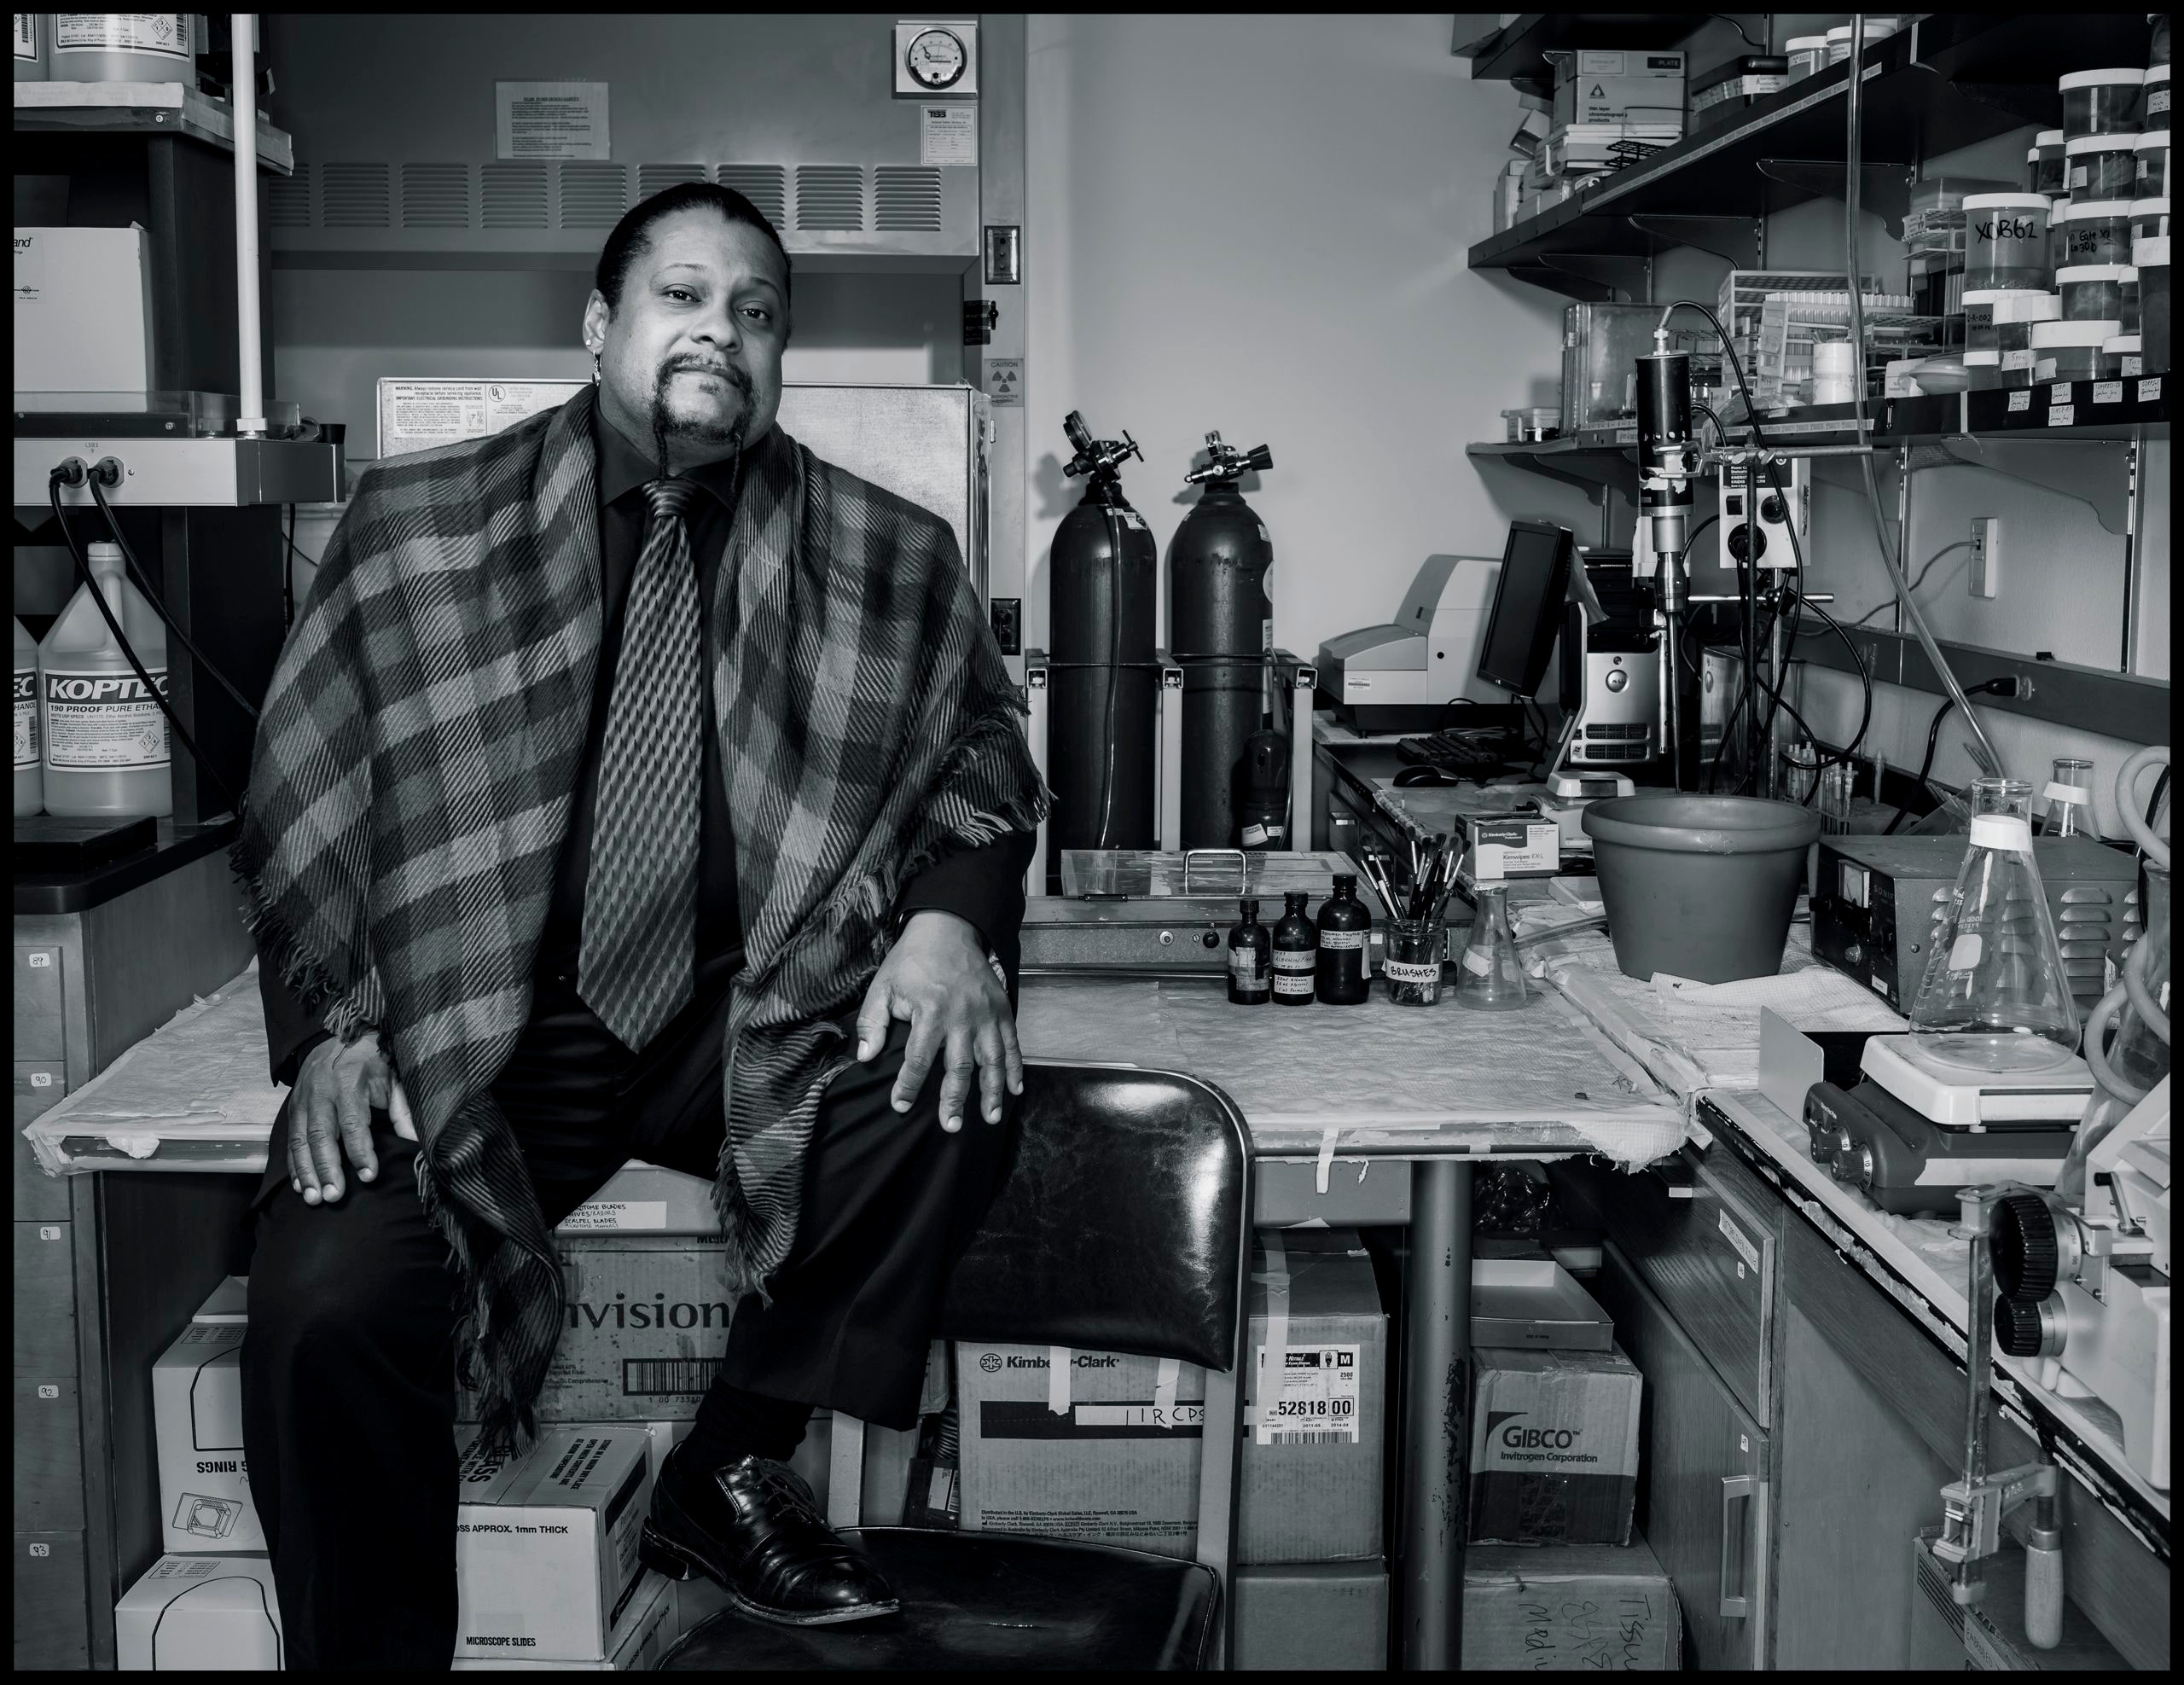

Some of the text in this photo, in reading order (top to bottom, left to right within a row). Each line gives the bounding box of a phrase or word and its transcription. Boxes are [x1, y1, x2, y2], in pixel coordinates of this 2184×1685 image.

[105, 705, 132, 713] PURE
[32, 956, 43, 967] 89
[1390, 966, 1437, 978] BRUSHES
[36, 1076, 47, 1084] 90
[43, 1229, 51, 1241] 91
[1340, 1355, 1350, 1365] M
[41, 1387, 55, 1397] 92
[1278, 1400, 1351, 1415] 52818 00
[1501, 1450, 1598, 1464] Invitrogen Corporation
[196, 1461, 237, 1473] RINGS
[472, 1525, 513, 1533] APPROX.
[514, 1525, 537, 1534] 1mm
[538, 1525, 569, 1534] THICK
[33, 1545, 47, 1557] 93
[466, 1636, 537, 1647] MICROSCOPE SLIDES
